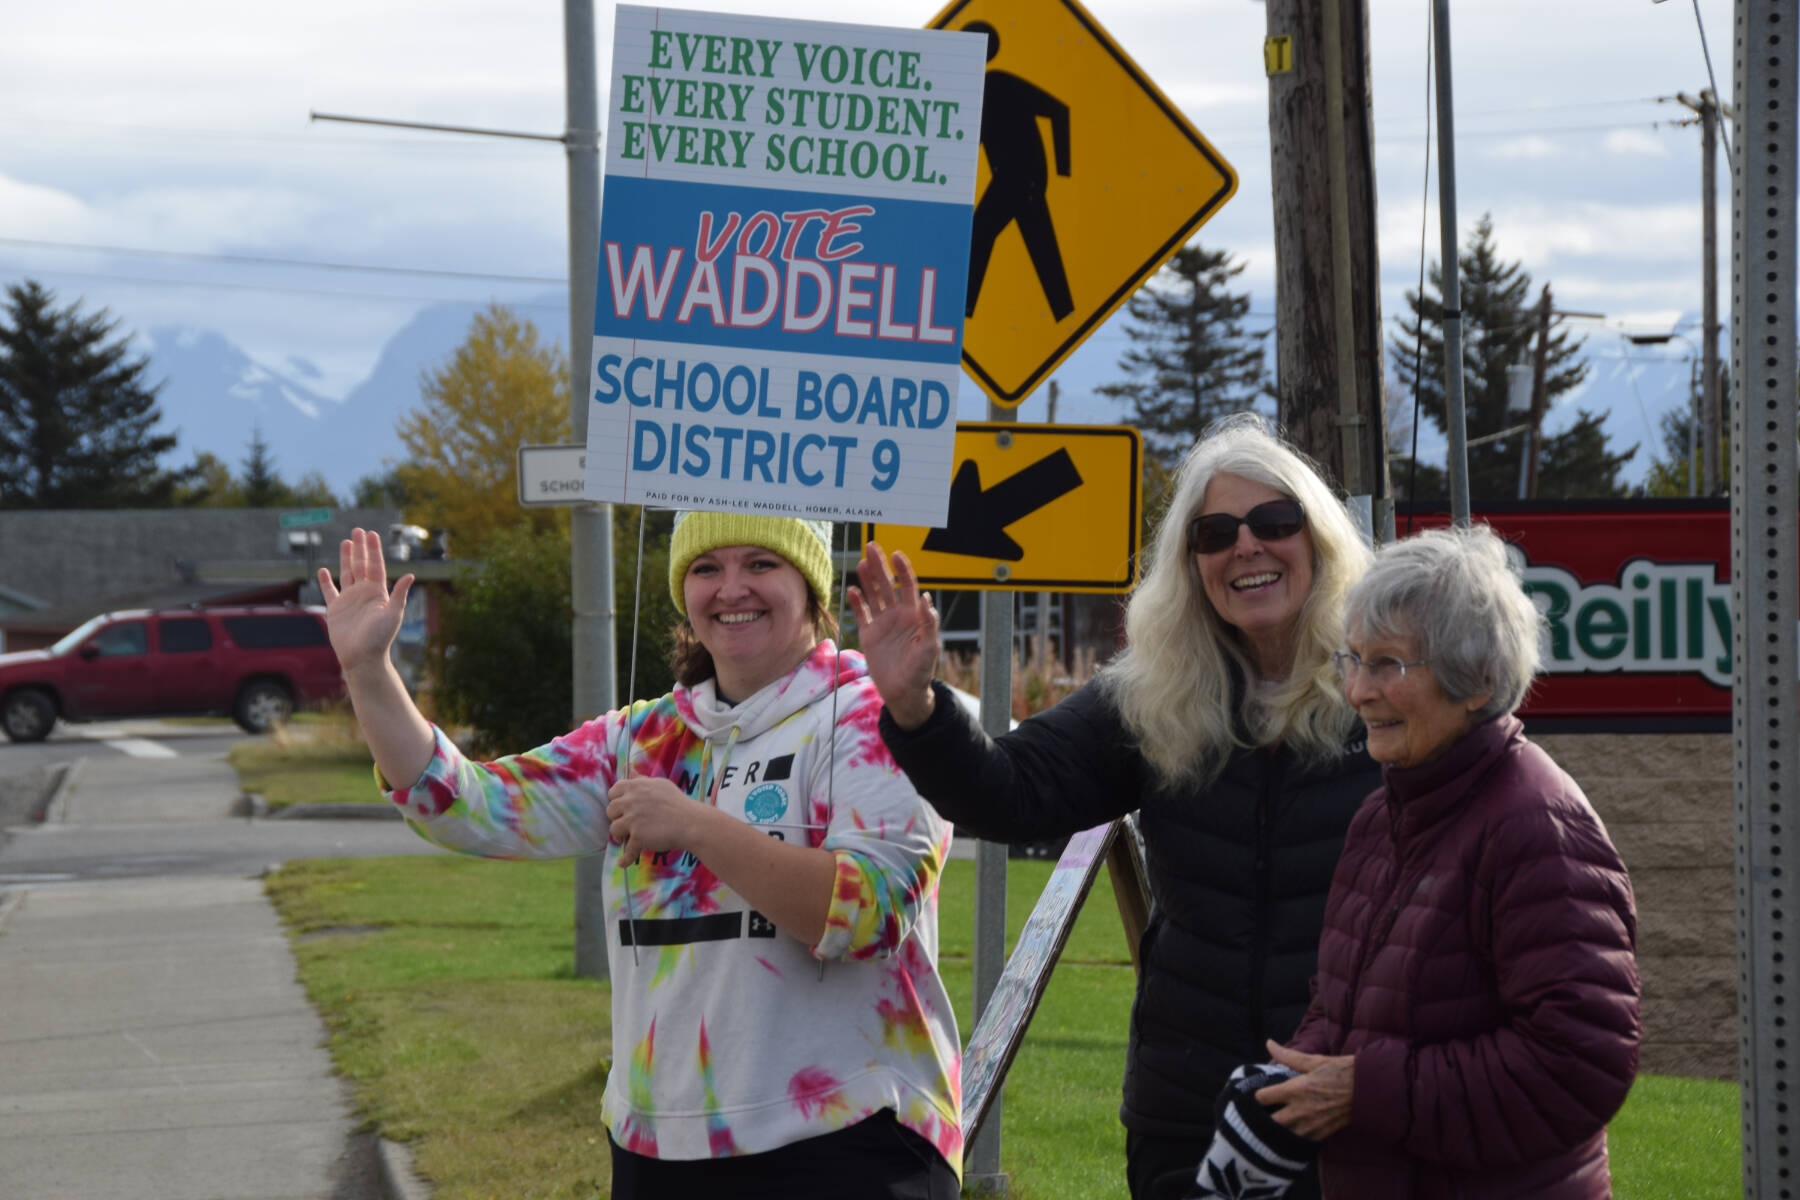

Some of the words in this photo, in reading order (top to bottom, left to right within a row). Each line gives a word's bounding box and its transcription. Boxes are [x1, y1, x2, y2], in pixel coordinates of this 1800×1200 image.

[648, 30, 783, 78] EVERY
[794, 42, 932, 92] VOICE.
[1272, 36, 1288, 70] T
[620, 74, 755, 122] EVERY
[765, 86, 964, 141] STUDENT.
[621, 121, 755, 168] EVERY
[766, 133, 948, 185] SCHOOL.
[695, 205, 876, 263] VOTE
[604, 241, 956, 344] WADDELL
[595, 354, 781, 418] SCHOOL
[795, 370, 950, 429] BOARD
[632, 419, 858, 488] DISTRICT
[870, 438, 900, 491] 9
[646, 491, 668, 500] PAID
[671, 493, 689, 503] FOR
[693, 496, 706, 504] BY
[708, 498, 750, 508] ASH-LEE
[753, 501, 802, 512] WADDELL,
[806, 505, 841, 515] HOMER,
[845, 508, 883, 517] ALASKA
